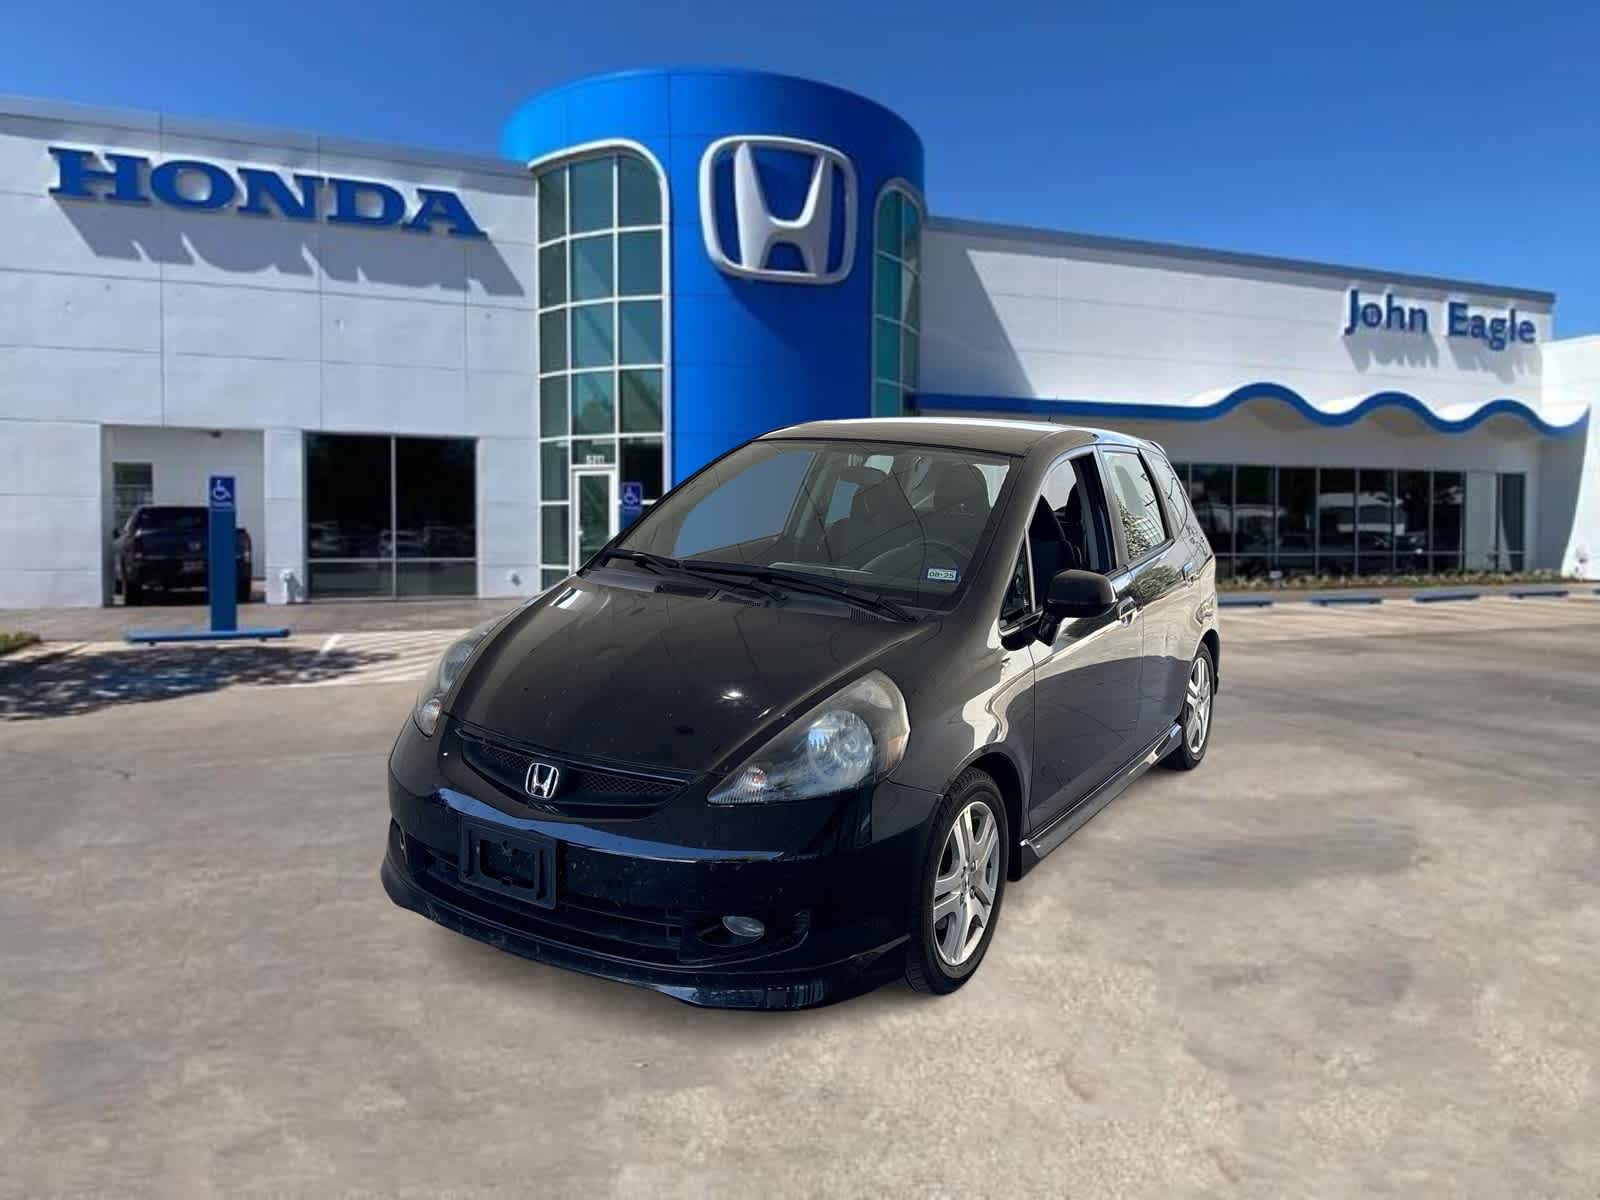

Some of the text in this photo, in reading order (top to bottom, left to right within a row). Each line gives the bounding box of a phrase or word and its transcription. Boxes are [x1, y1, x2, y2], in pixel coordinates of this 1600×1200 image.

[47, 145, 489, 240] HONDA
[1344, 288, 1537, 351] John Eagle
